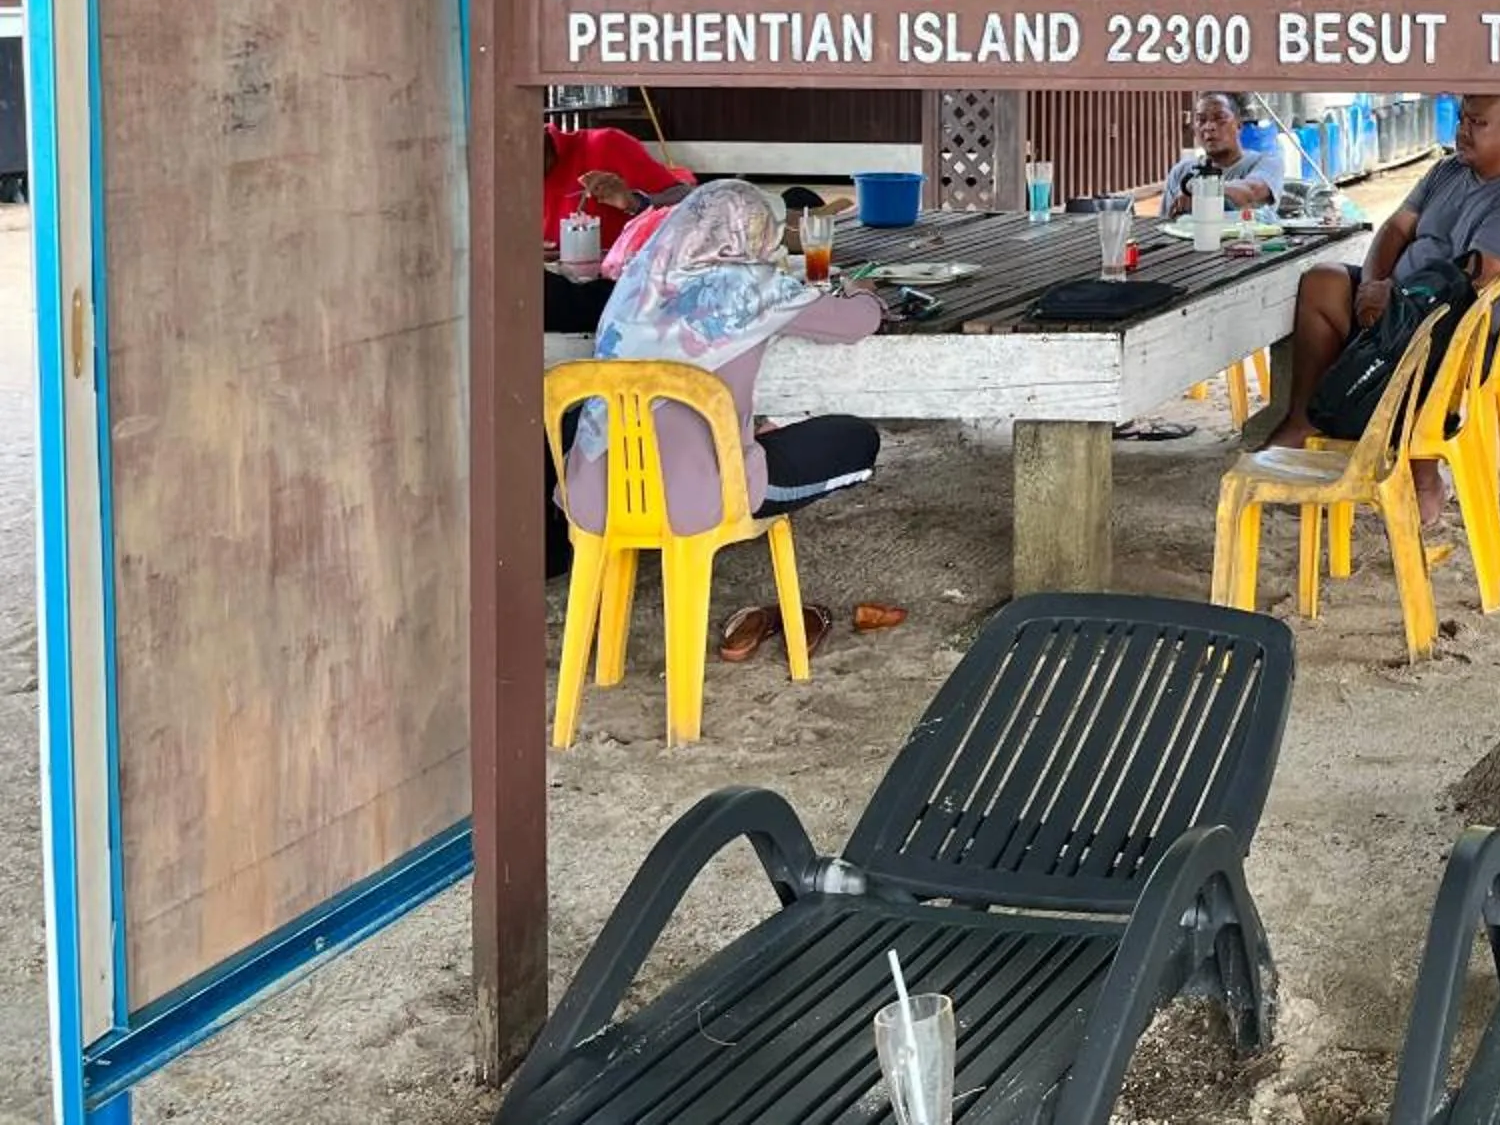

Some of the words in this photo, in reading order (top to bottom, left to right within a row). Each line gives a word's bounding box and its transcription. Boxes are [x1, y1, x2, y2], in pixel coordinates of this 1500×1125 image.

[568, 11, 874, 64] PERHENTIAN
[898, 11, 1081, 64] ISLAND
[1105, 13, 1252, 64] 22300
[1277, 12, 1446, 65] BESUT
